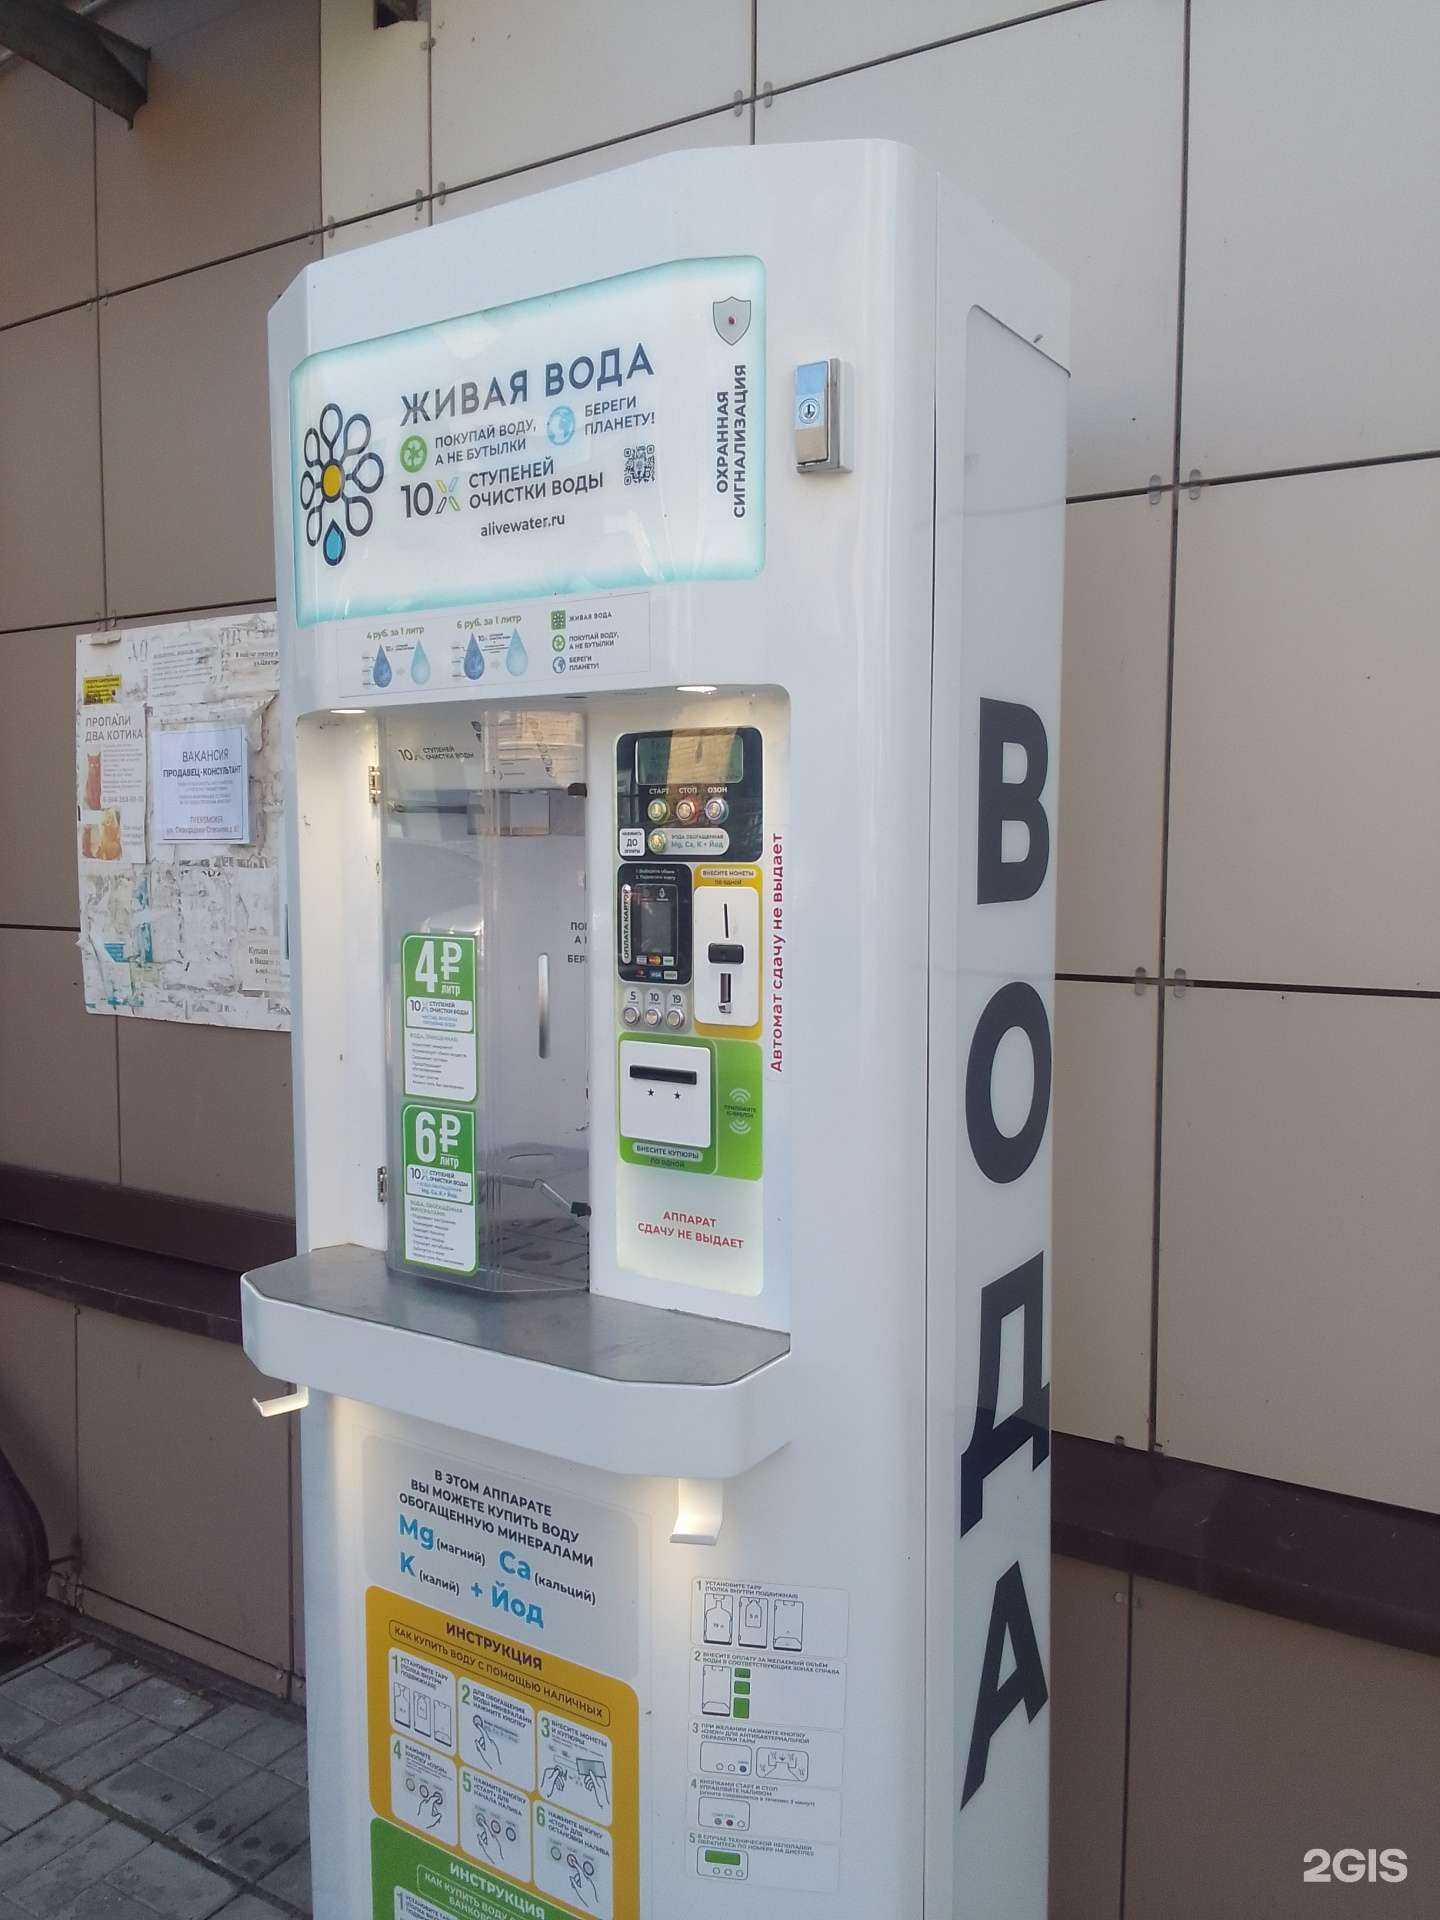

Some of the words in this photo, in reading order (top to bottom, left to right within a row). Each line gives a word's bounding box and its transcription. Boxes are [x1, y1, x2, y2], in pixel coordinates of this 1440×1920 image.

[400, 370, 529, 427] ЖИВАЯ
[545, 342, 655, 397] ВОДА
[584, 396, 638, 418] БЕРЕГИ
[435, 423, 496, 449] ПОКУПАЙ
[499, 418, 538, 442] ВОДУ,
[584, 411, 656, 436] ПЛАНЕТУ!
[716, 391, 728, 493] ОХРАННАЯ
[733, 363, 747, 519] СИГНАЛИЗАЦИЯ
[435, 453, 445, 466] А
[447, 450, 464, 464] НЕ
[466, 438, 527, 462] БУТЫЛКИ
[469, 456, 554, 489] СТУПЕНЕЙ
[469, 483, 547, 510] ОЧИСТКИ
[552, 472, 604, 496] ВОДЫ
[480, 514, 566, 537] alivewater.ru
[456, 620, 463, 630] 6
[484, 617, 494, 627] за
[500, 614, 522, 628] литр
[569, 613, 592, 622] ЖИВАЯ
[594, 611, 613, 620] ВОДА
[366, 629, 373, 639] 4
[391, 627, 400, 637] за
[405, 624, 425, 638] литр
[569, 632, 598, 643] ПОКУПАЙ
[600, 630, 619, 640] ВОДУ,
[575, 641, 584, 649] НЕ
[585, 639, 615, 649] БУТЫЛКИ
[569, 656, 593, 664] БЕРЕГИ
[569, 661, 600, 671] ПЛАНЕТУ!
[86, 714, 131, 728] ПРОПАЛИ
[85, 731, 105, 743] ДВА
[107, 729, 144, 741] КОТИКА
[182, 748, 229, 763] ВАКАНСИЯ
[163, 765, 242, 778] ПРОДАВЕЦ-КОНСУЛЬТАНТ
[707, 786, 727, 794] ОЗОН
[627, 838, 638, 848] ДО
[773, 833, 783, 903] выдает
[773, 909, 782, 930] не
[773, 935, 785, 990] сдачу
[441, 985, 461, 996] литр
[631, 992, 636, 1000] 5
[650, 993, 659, 1001] 10
[672, 994, 681, 1002] 19
[771, 995, 782, 1072] Автомат
[636, 1144, 667, 1156] ВНЕСИТЕ
[440, 1157, 459, 1169] литр
[663, 1210, 717, 1228] АППАРАТ
[637, 1222, 675, 1237] СДАЧУ
[678, 1229, 692, 1240] НЕ
[695, 1232, 744, 1249] ВЫДАЕТ
[959, 696, 1051, 1810] ВОДА
[434, 1469, 443, 1481] В
[445, 1472, 479, 1493] ЭТОМ
[482, 1484, 552, 1517] АППАРАТЕ
[411, 1479, 430, 1495] ВЫ
[432, 1487, 485, 1512] МОЖЕТЕ
[487, 1504, 538, 1531] КУПИТЬ
[541, 1520, 580, 1544] ВОДУ
[399, 1493, 495, 1534] ОБОГАЩЕННУЮ
[497, 1524, 594, 1567] МИНЕРАЛАМИ
[399, 1514, 435, 1551] Mg
[436, 1537, 487, 1567] (магний)
[499, 1550, 531, 1581] Ca
[534, 1571, 597, 1606] (кальций)
[419, 1569, 460, 1596] (калий)
[471, 1582, 483, 1597] +
[491, 1580, 544, 1629] Йод
[446, 1622, 543, 1671] ИНСТРУКЦИЯ
[694, 1651, 701, 1661] 2
[392, 1654, 399, 1674] 1
[394, 1625, 413, 1640] КАК
[413, 1632, 449, 1655] КУПИТЬ
[450, 1647, 477, 1667] ВОДУ
[478, 1660, 486, 1670] С
[486, 1663, 541, 1693] ПОМОЩЬЮ
[543, 1683, 603, 1718] НАЛИЧНЫХ
[462, 1687, 470, 1705] 2
[541, 1717, 550, 1738] 3
[692, 1723, 699, 1733] 3
[394, 1741, 402, 1760] 4
[463, 1771, 472, 1792] 5
[690, 1779, 697, 1789] 4
[536, 1806, 545, 1827] 6
[689, 1833, 696, 1843] 5
[444, 1882, 480, 1907] КУПИТЬ
[482, 1899, 508, 1919] ВОДУ
[450, 1862, 545, 1919] ИНСТРУКЦИЯ
